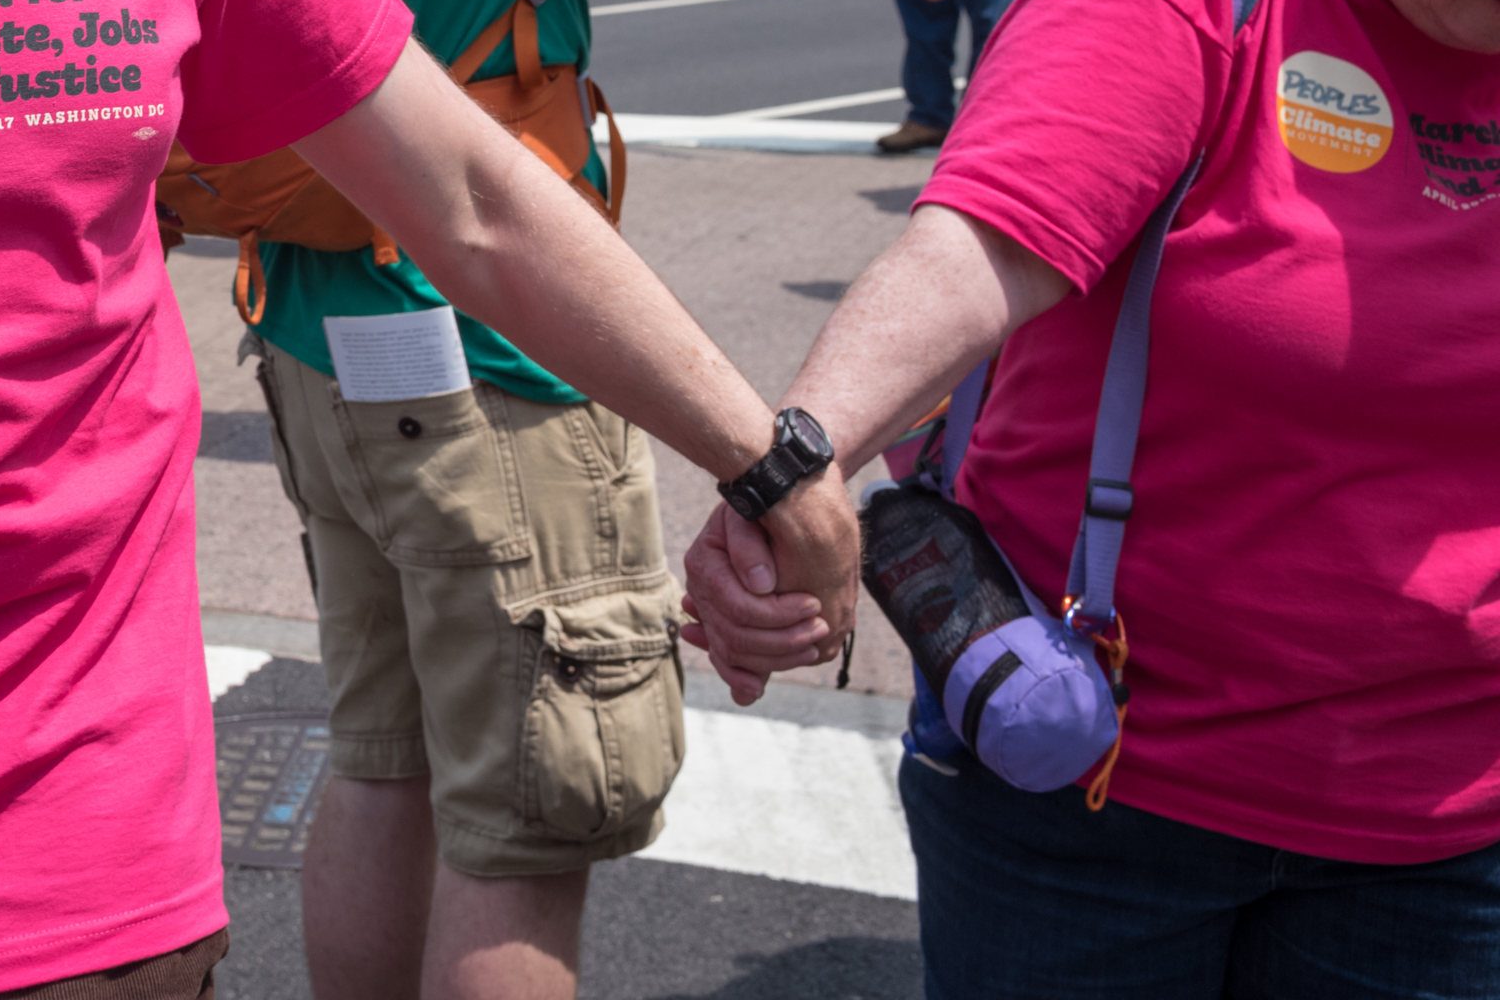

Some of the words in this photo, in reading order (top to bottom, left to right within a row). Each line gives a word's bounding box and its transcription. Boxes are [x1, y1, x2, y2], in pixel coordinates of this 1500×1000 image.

[72, 8, 160, 48] Jobs
[1283, 70, 1380, 115] PEOPLES
[25, 104, 144, 127] WASHINGTON
[148, 103, 165, 117] DC
[1280, 105, 1381, 148] Climate
[1286, 128, 1373, 158] MOVEMENT
